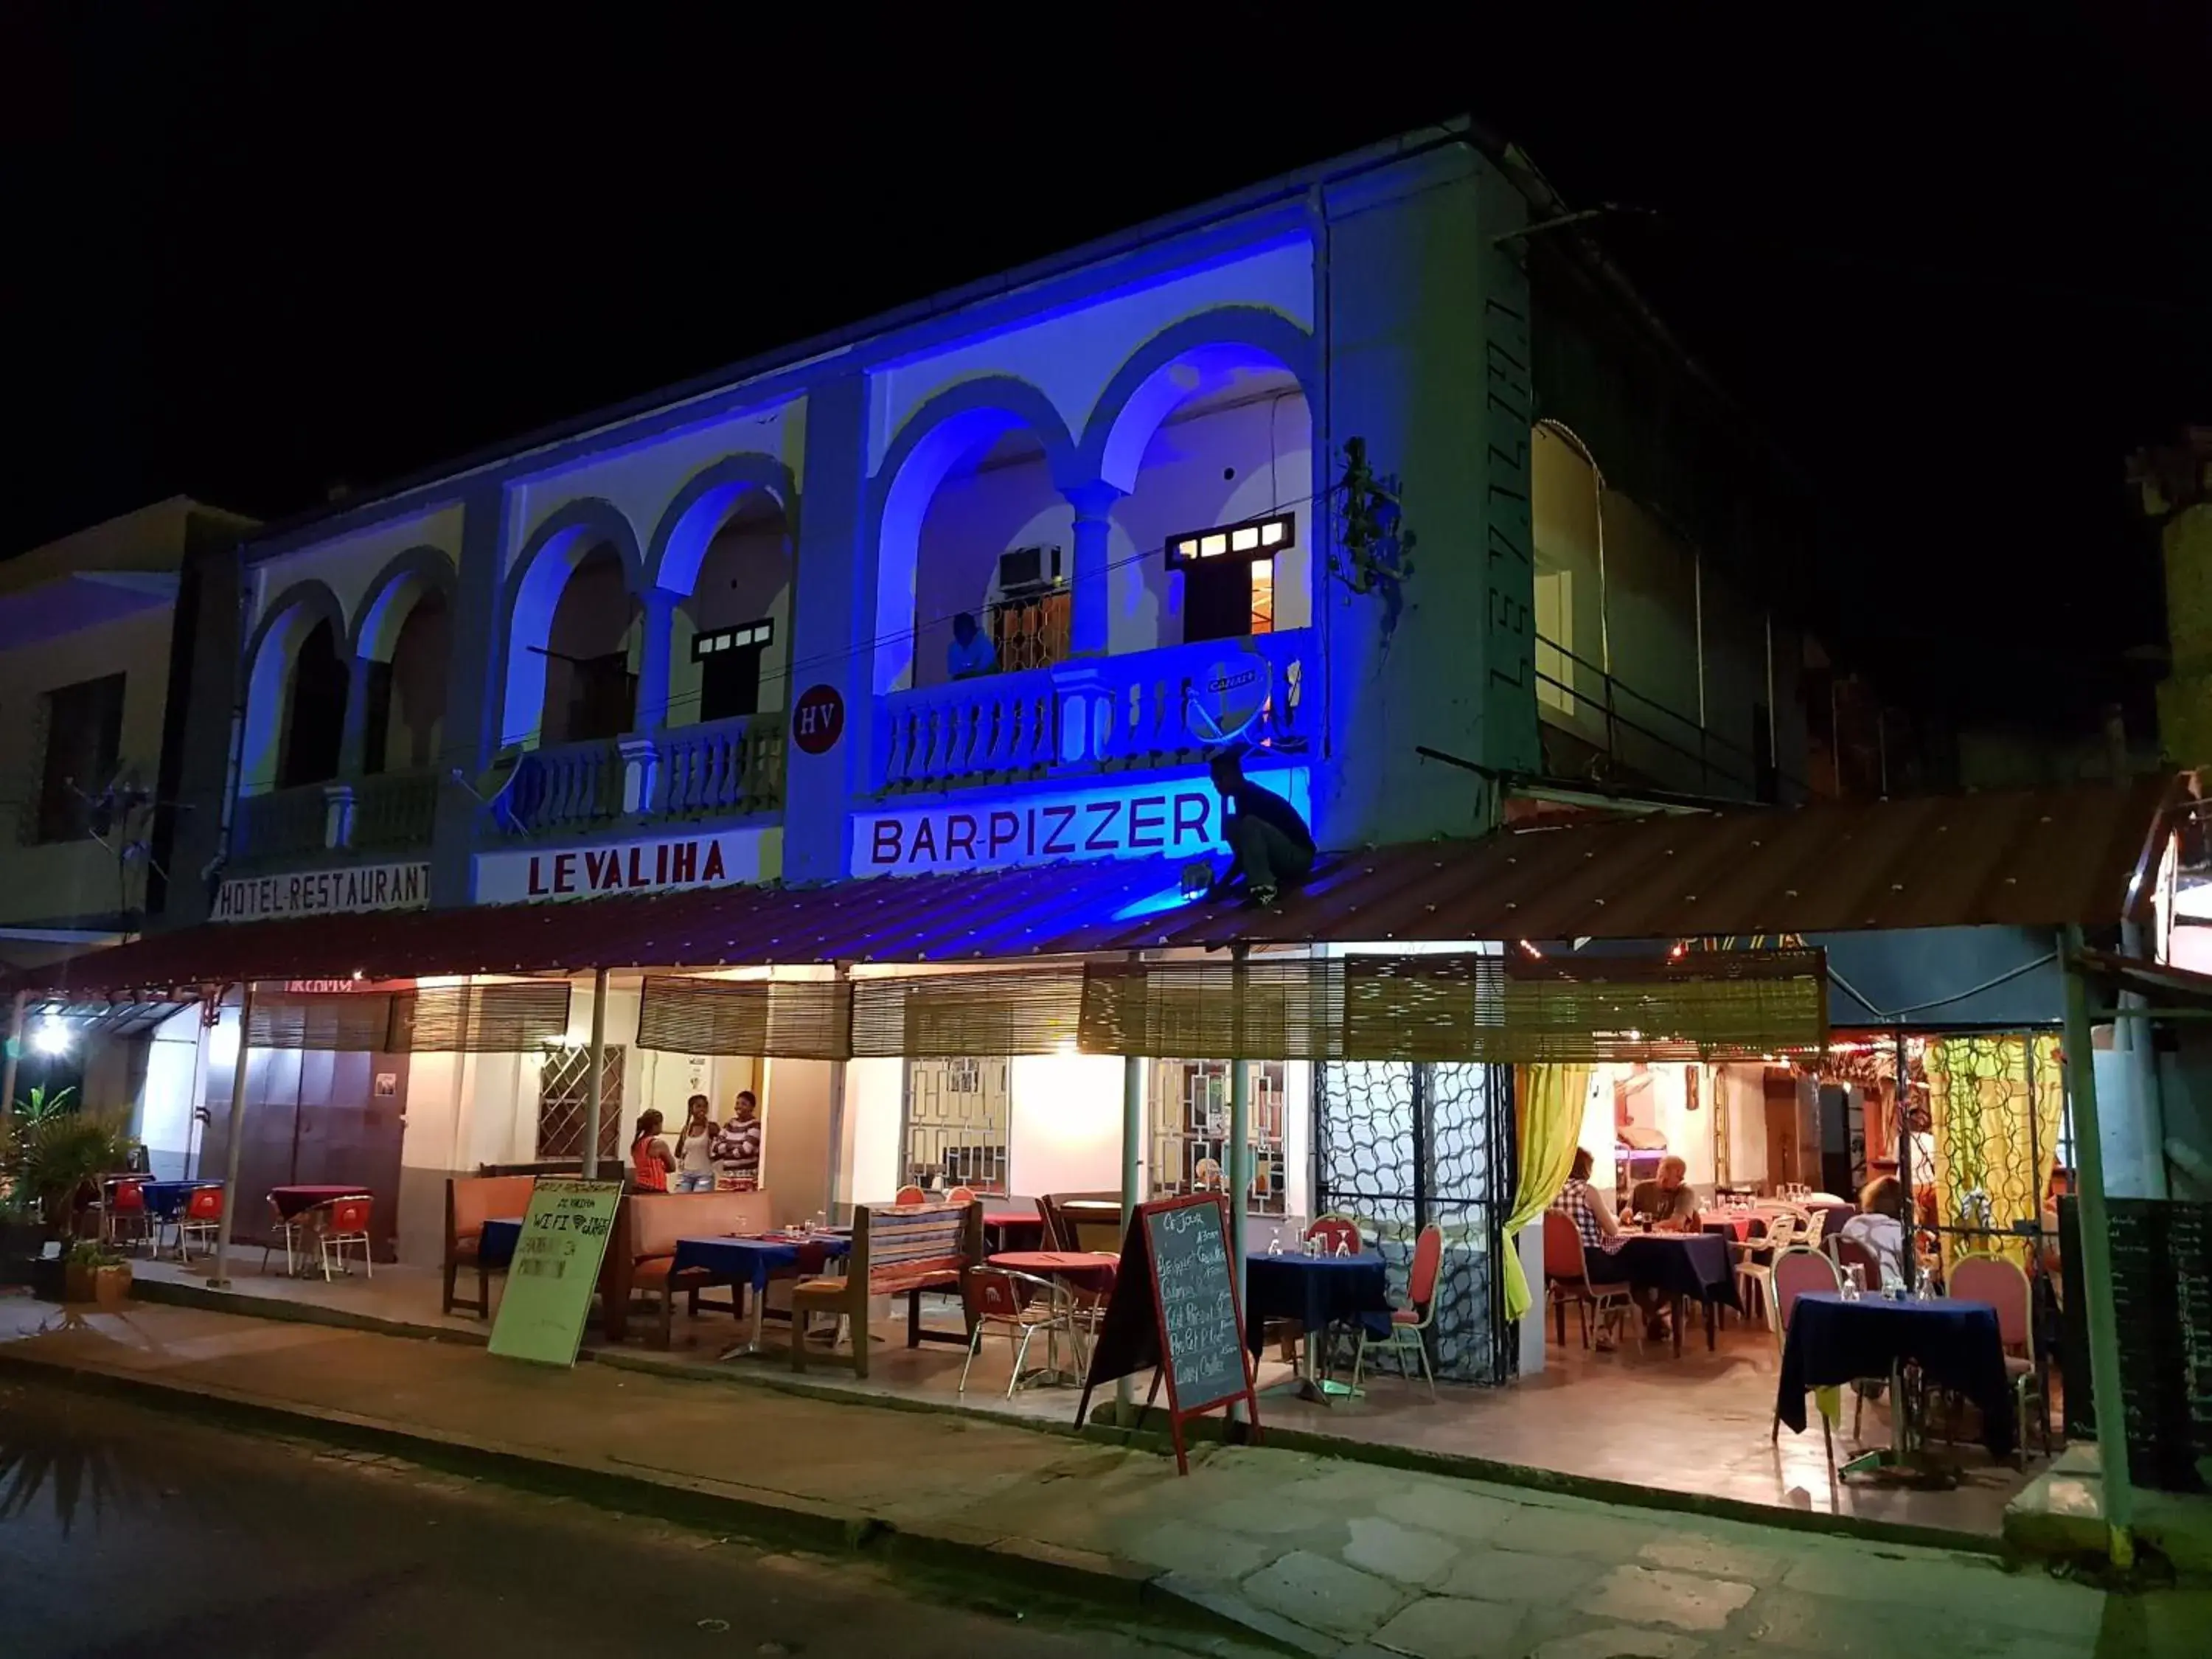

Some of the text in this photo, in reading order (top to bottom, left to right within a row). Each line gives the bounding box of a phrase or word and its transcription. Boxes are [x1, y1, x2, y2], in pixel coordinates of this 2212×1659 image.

[800, 702, 836, 736] HV
[872, 792, 1230, 864] BAR-PIZZERI
[220, 863, 431, 915] HOTEL-RESTAURANT
